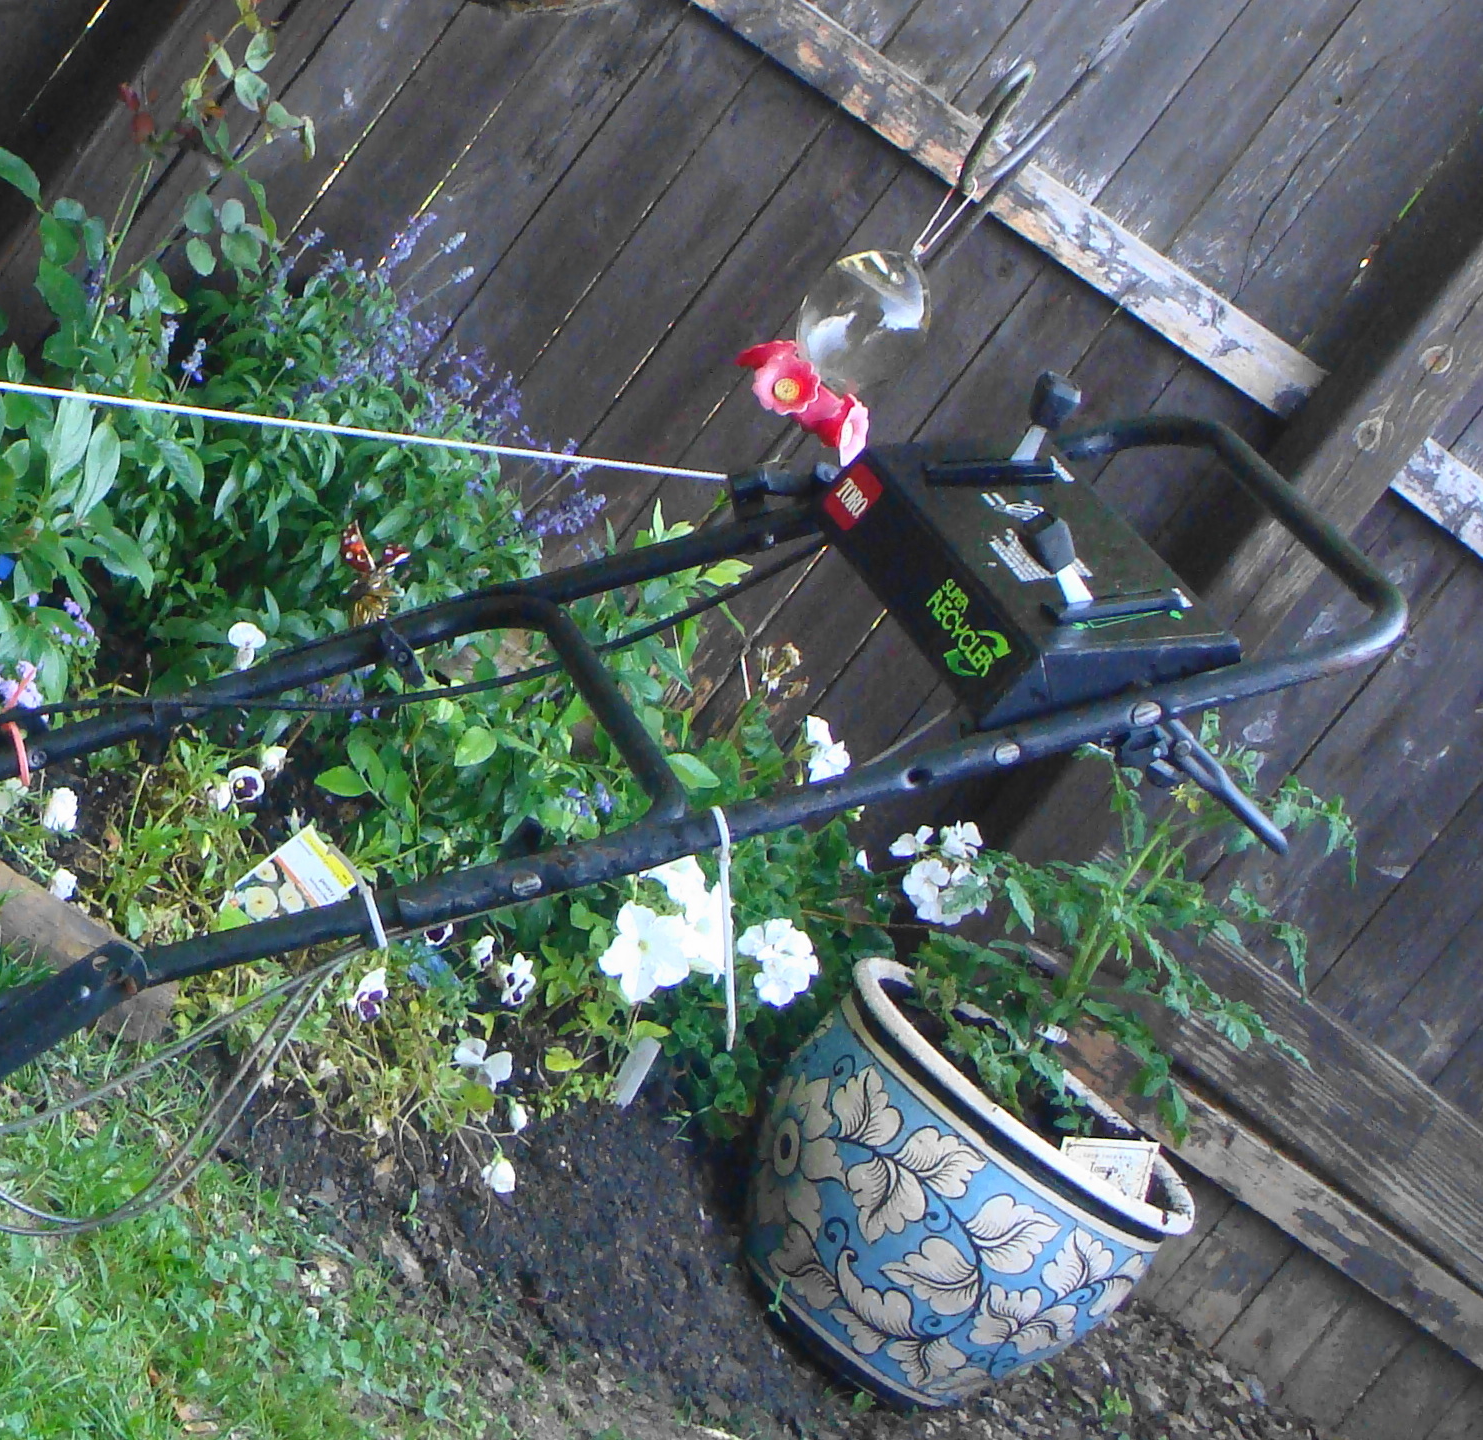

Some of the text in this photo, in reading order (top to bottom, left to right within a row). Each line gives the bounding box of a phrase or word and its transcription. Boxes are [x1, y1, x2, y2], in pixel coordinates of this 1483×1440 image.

[835, 477, 868, 518] TORO
[942, 578, 969, 613] SUPER
[925, 589, 994, 677] RECYCLER
